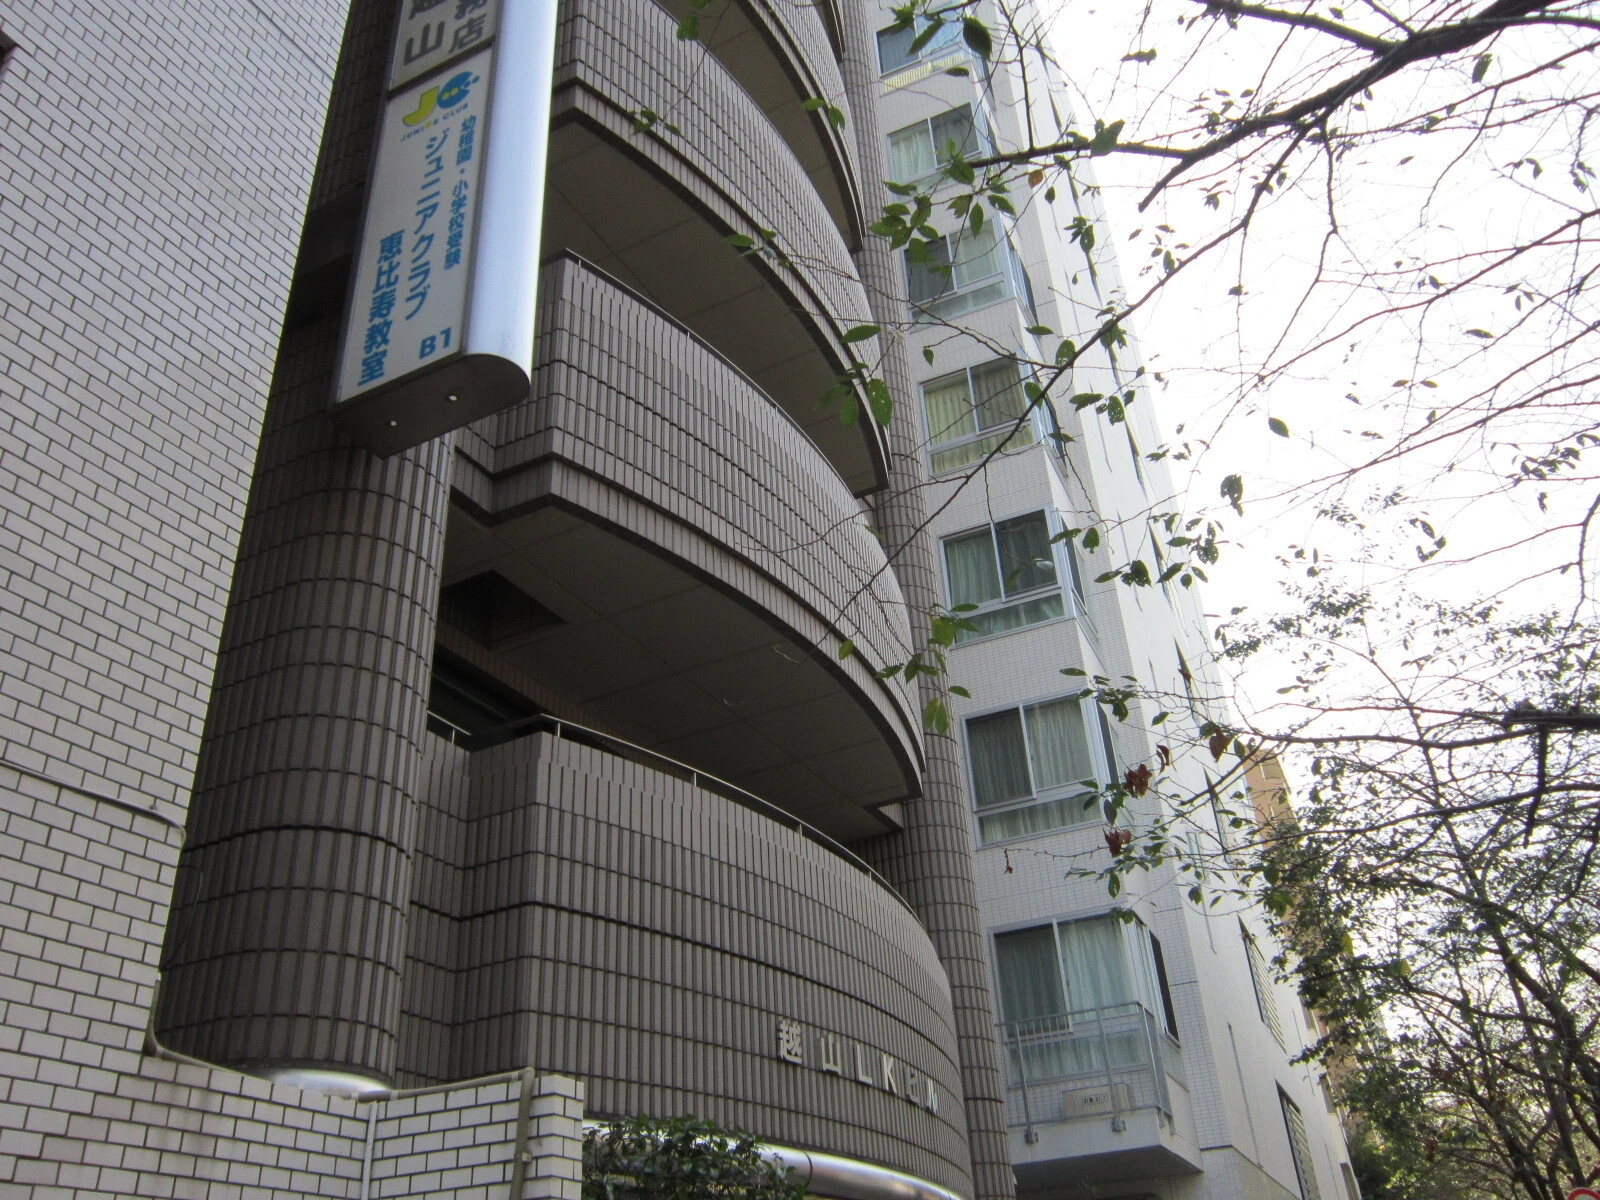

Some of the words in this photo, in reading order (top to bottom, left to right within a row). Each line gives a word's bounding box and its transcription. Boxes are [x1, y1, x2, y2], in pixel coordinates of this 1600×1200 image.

[400, 118, 439, 142] JUNIOR
[442, 102, 469, 121] CLUB
[405, 127, 450, 321] ジュニアクラブ
[357, 228, 405, 387] 恵比寿教室
[418, 327, 451, 359] B1
